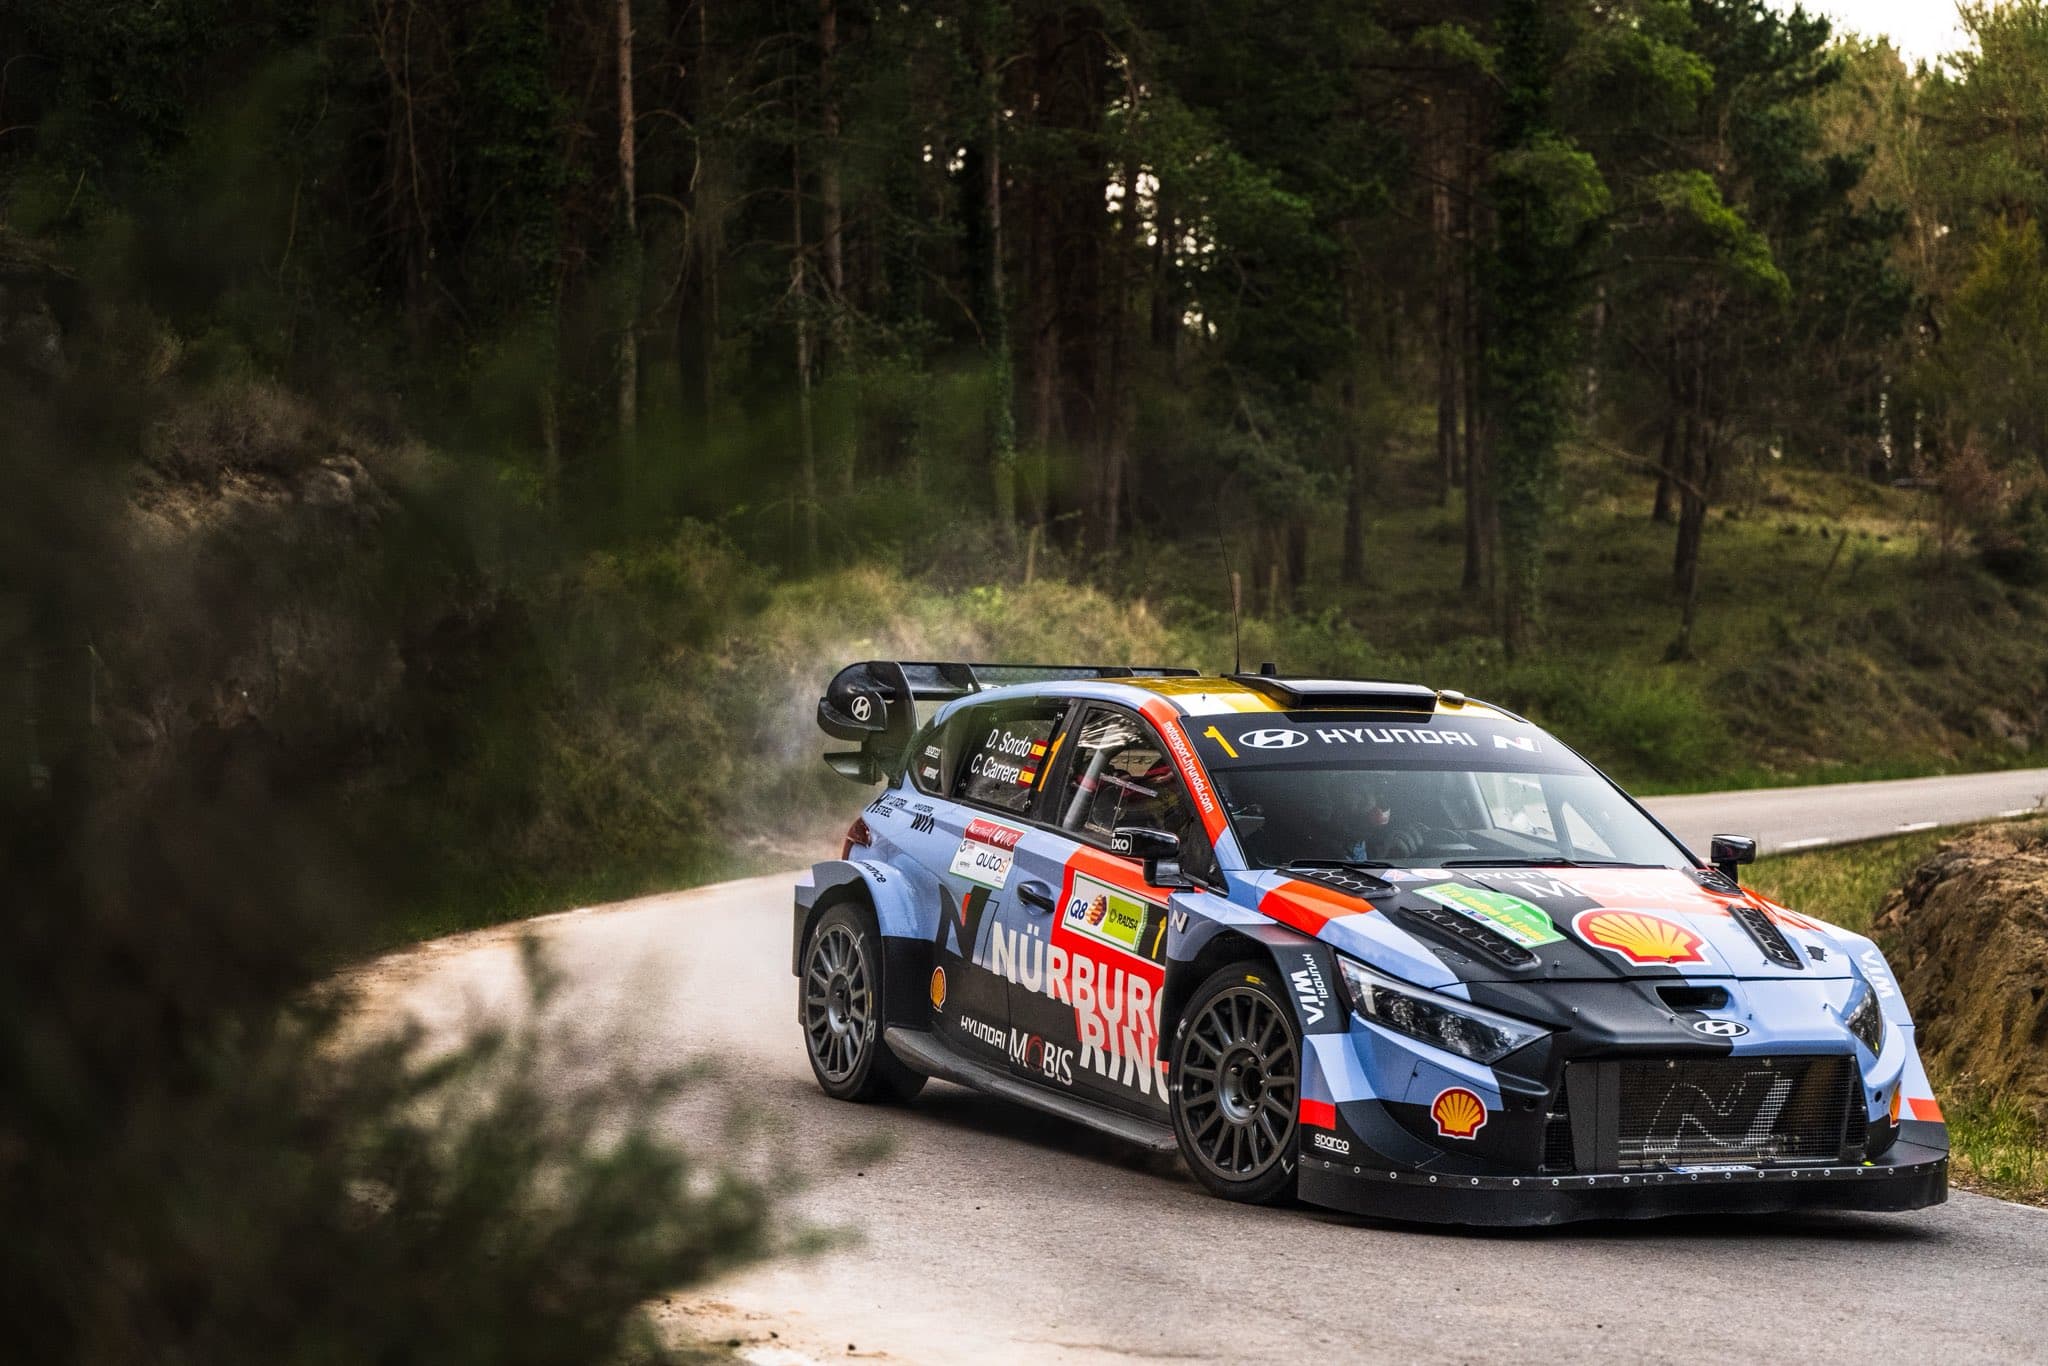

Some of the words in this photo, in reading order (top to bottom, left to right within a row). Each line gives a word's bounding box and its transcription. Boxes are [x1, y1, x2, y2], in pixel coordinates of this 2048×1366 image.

[986, 728, 999, 750] D.
[998, 731, 1032, 758] Sordo
[1203, 725, 1239, 759] 1
[1316, 728, 1478, 747] HYUNDAI
[971, 753, 982, 775] C.
[982, 756, 1019, 785] Carrera
[1162, 720, 1215, 814] motorsport.hyundai.com
[1070, 899, 1089, 920] Q8
[1117, 913, 1138, 931] RADSA
[1170, 910, 1189, 933] N
[1302, 953, 1329, 998] HYUNDAI
[1290, 969, 1325, 1025] WIA
[960, 1015, 1007, 1050] HYUNDAI
[1009, 1027, 1074, 1086] MOBIS
[1314, 1133, 1350, 1152] sparco
